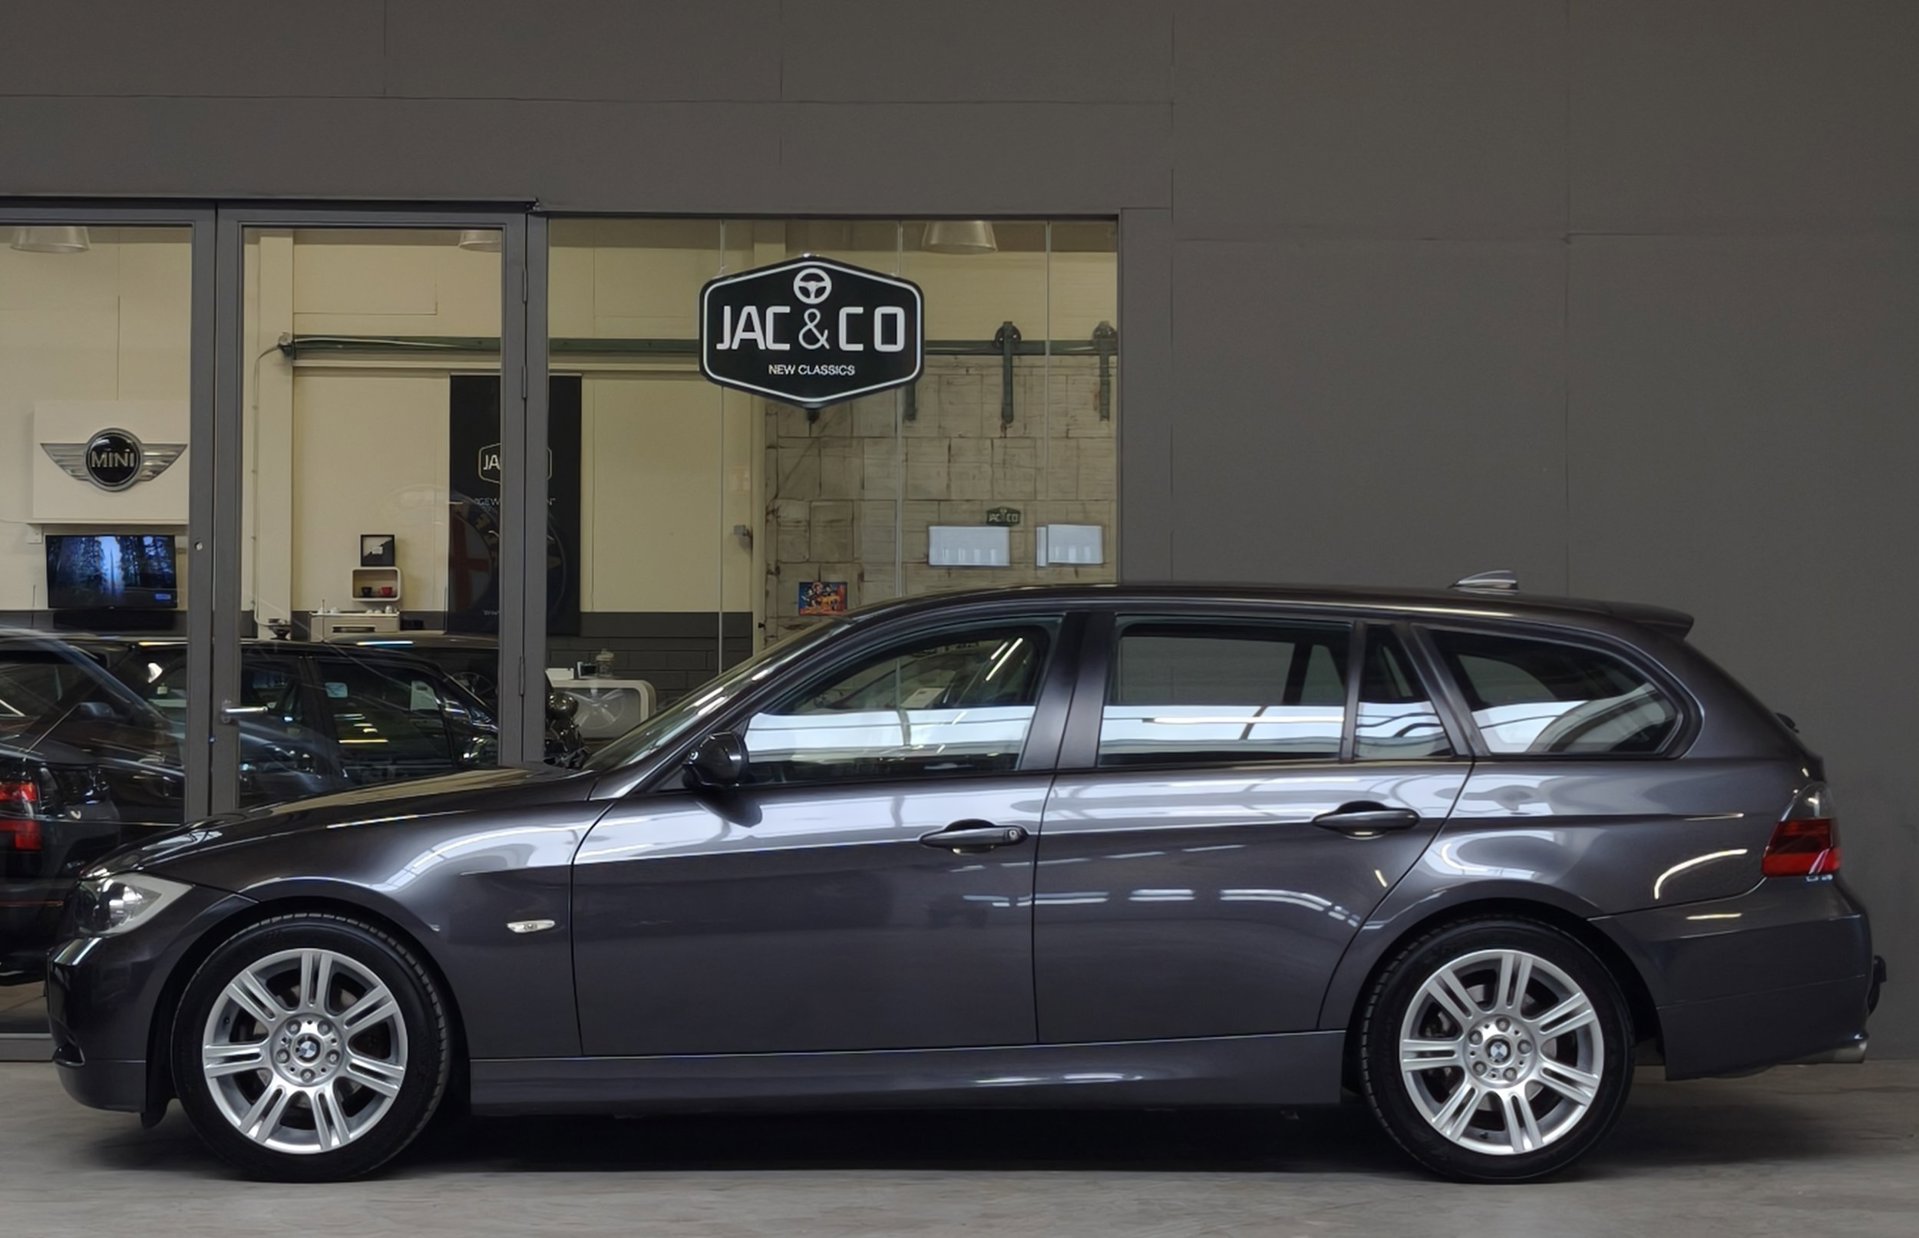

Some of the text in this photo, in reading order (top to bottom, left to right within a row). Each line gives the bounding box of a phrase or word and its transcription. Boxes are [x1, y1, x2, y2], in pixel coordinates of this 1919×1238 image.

[768, 364, 856, 376] NEW CLASSICS
[91, 451, 135, 468] MINI
